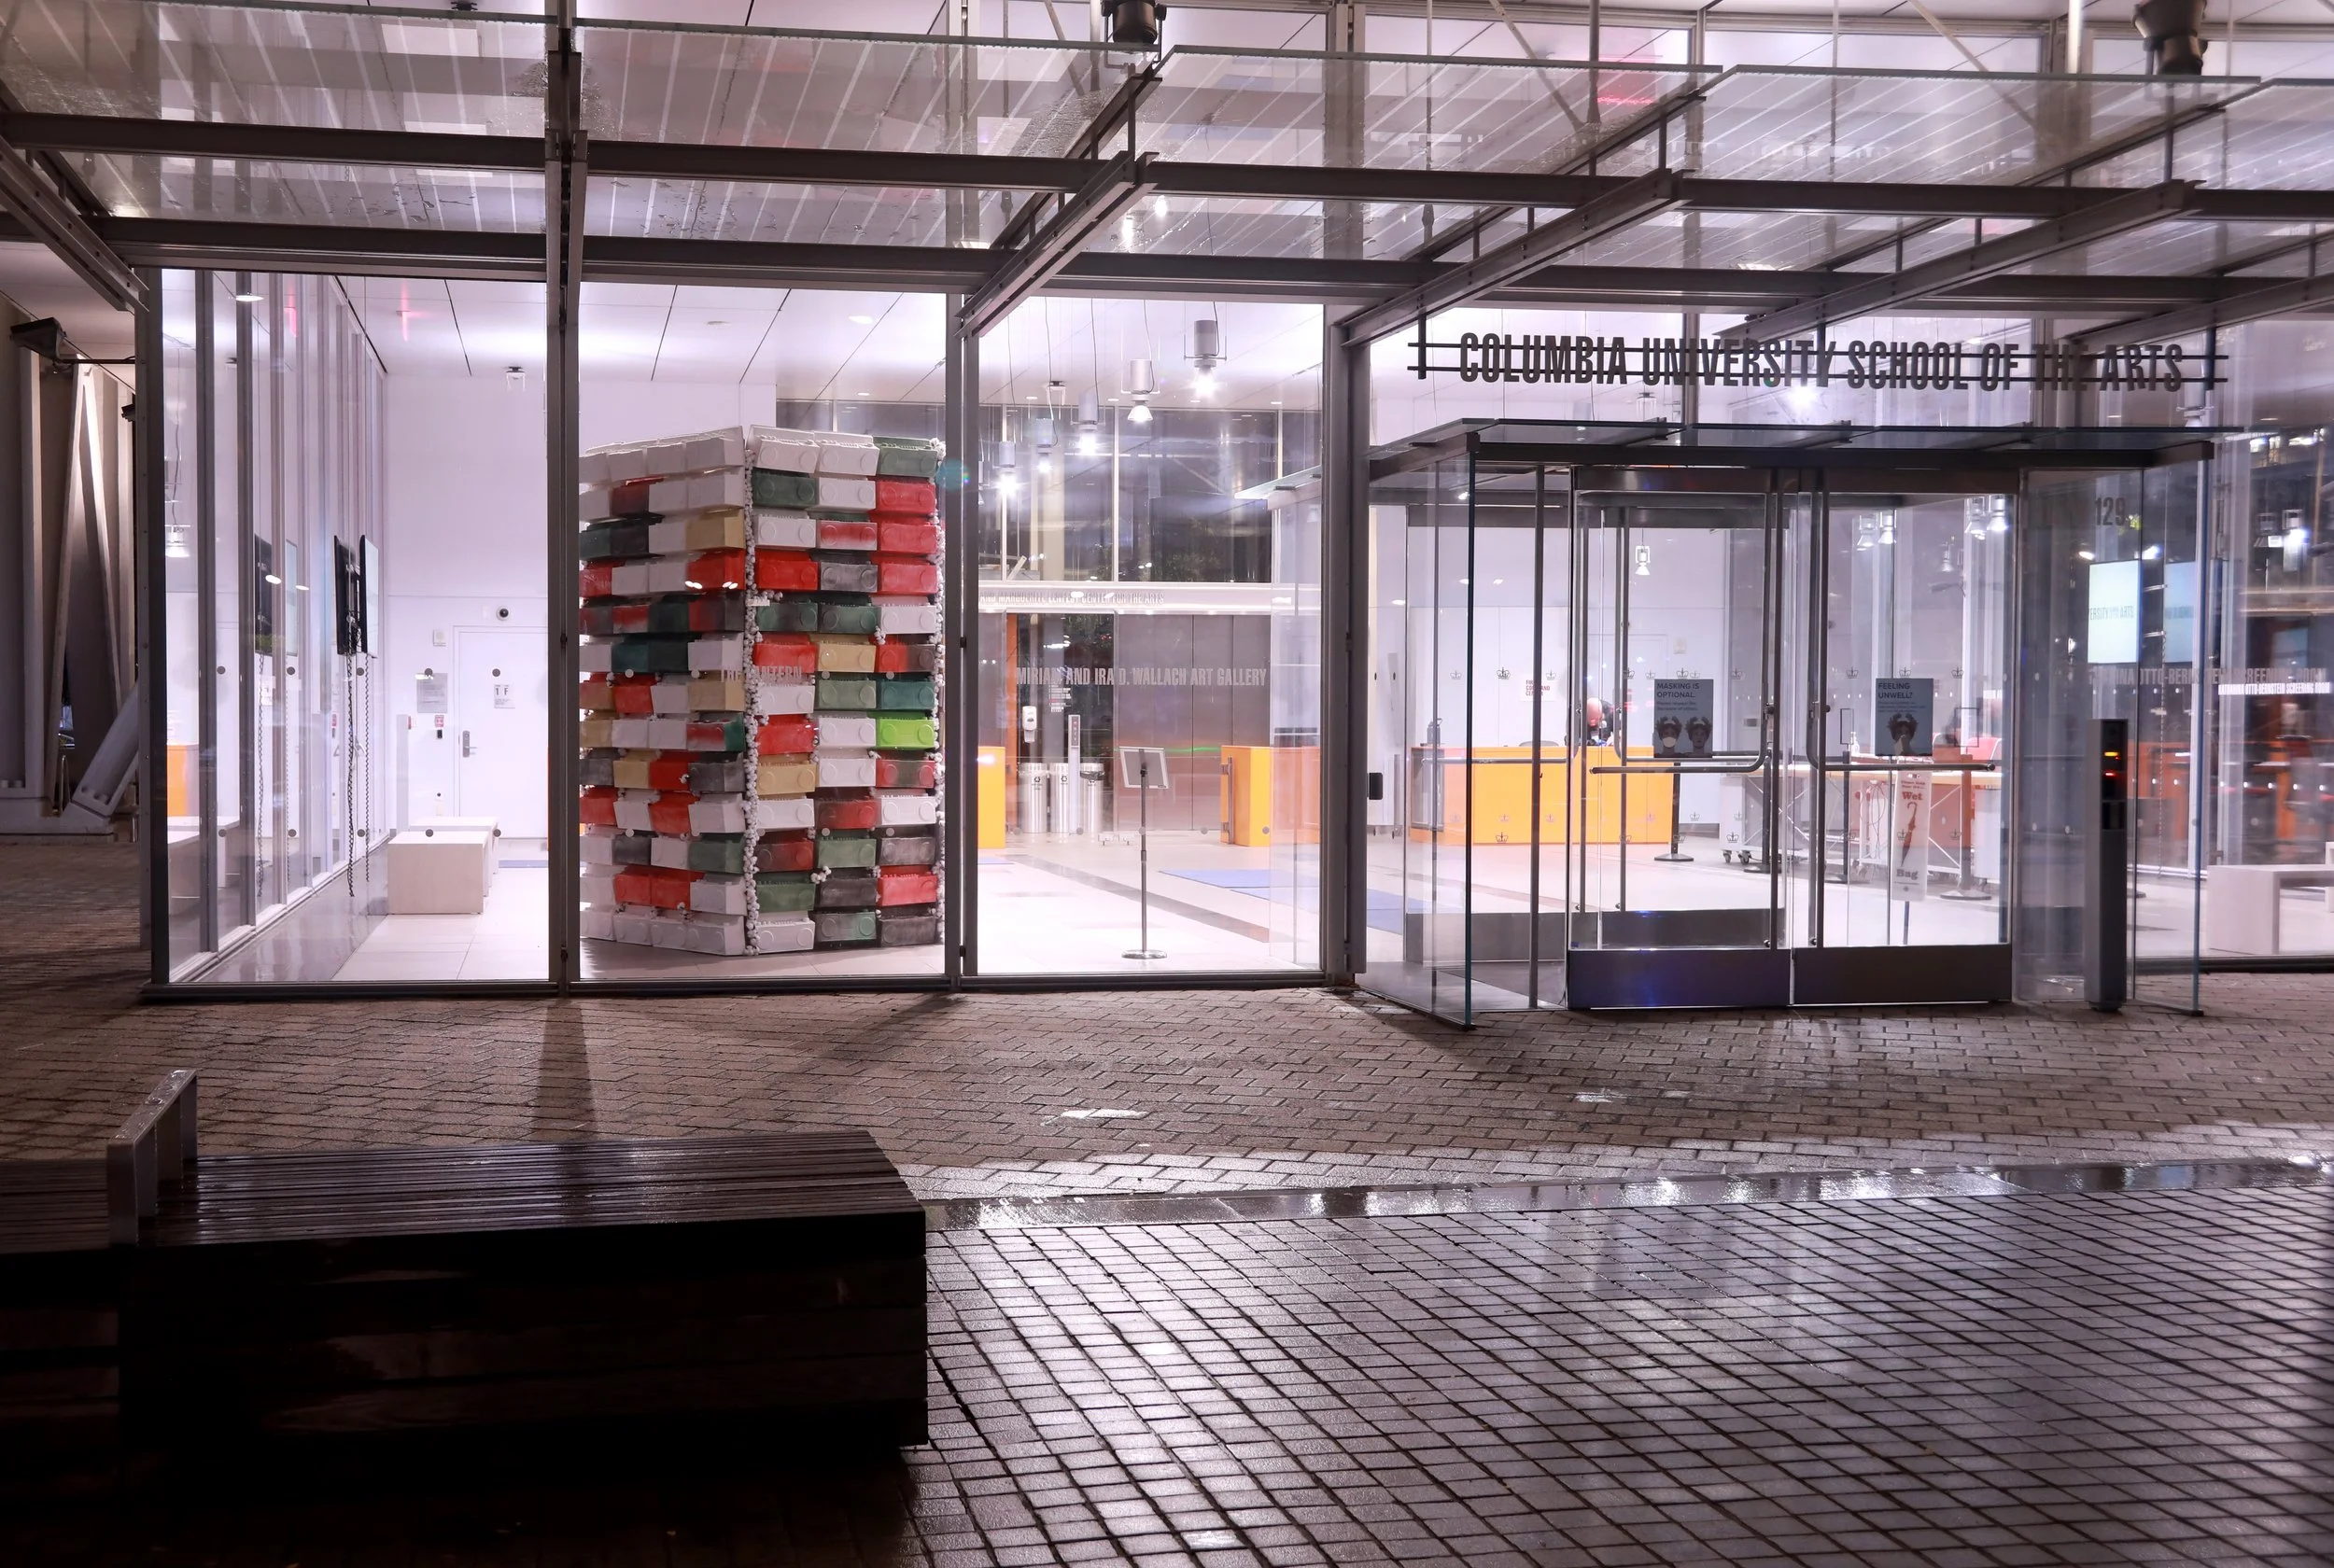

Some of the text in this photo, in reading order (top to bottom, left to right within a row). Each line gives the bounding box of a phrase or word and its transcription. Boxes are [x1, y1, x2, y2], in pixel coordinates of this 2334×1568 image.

[1459, 332, 2184, 392] COLUMBIA UNIVERSITY SCHOOL OF THE ARTS
[2094, 497, 2127, 526] 129
[751, 665, 803, 680] ANTERN
[1094, 667, 1115, 686] IRA
[1132, 667, 1187, 686] WALLACH
[1189, 668, 1214, 686] ART
[1216, 667, 1267, 686] GALLERY
[1902, 791, 1923, 801] Wet
[1896, 869, 1919, 880] Bag
